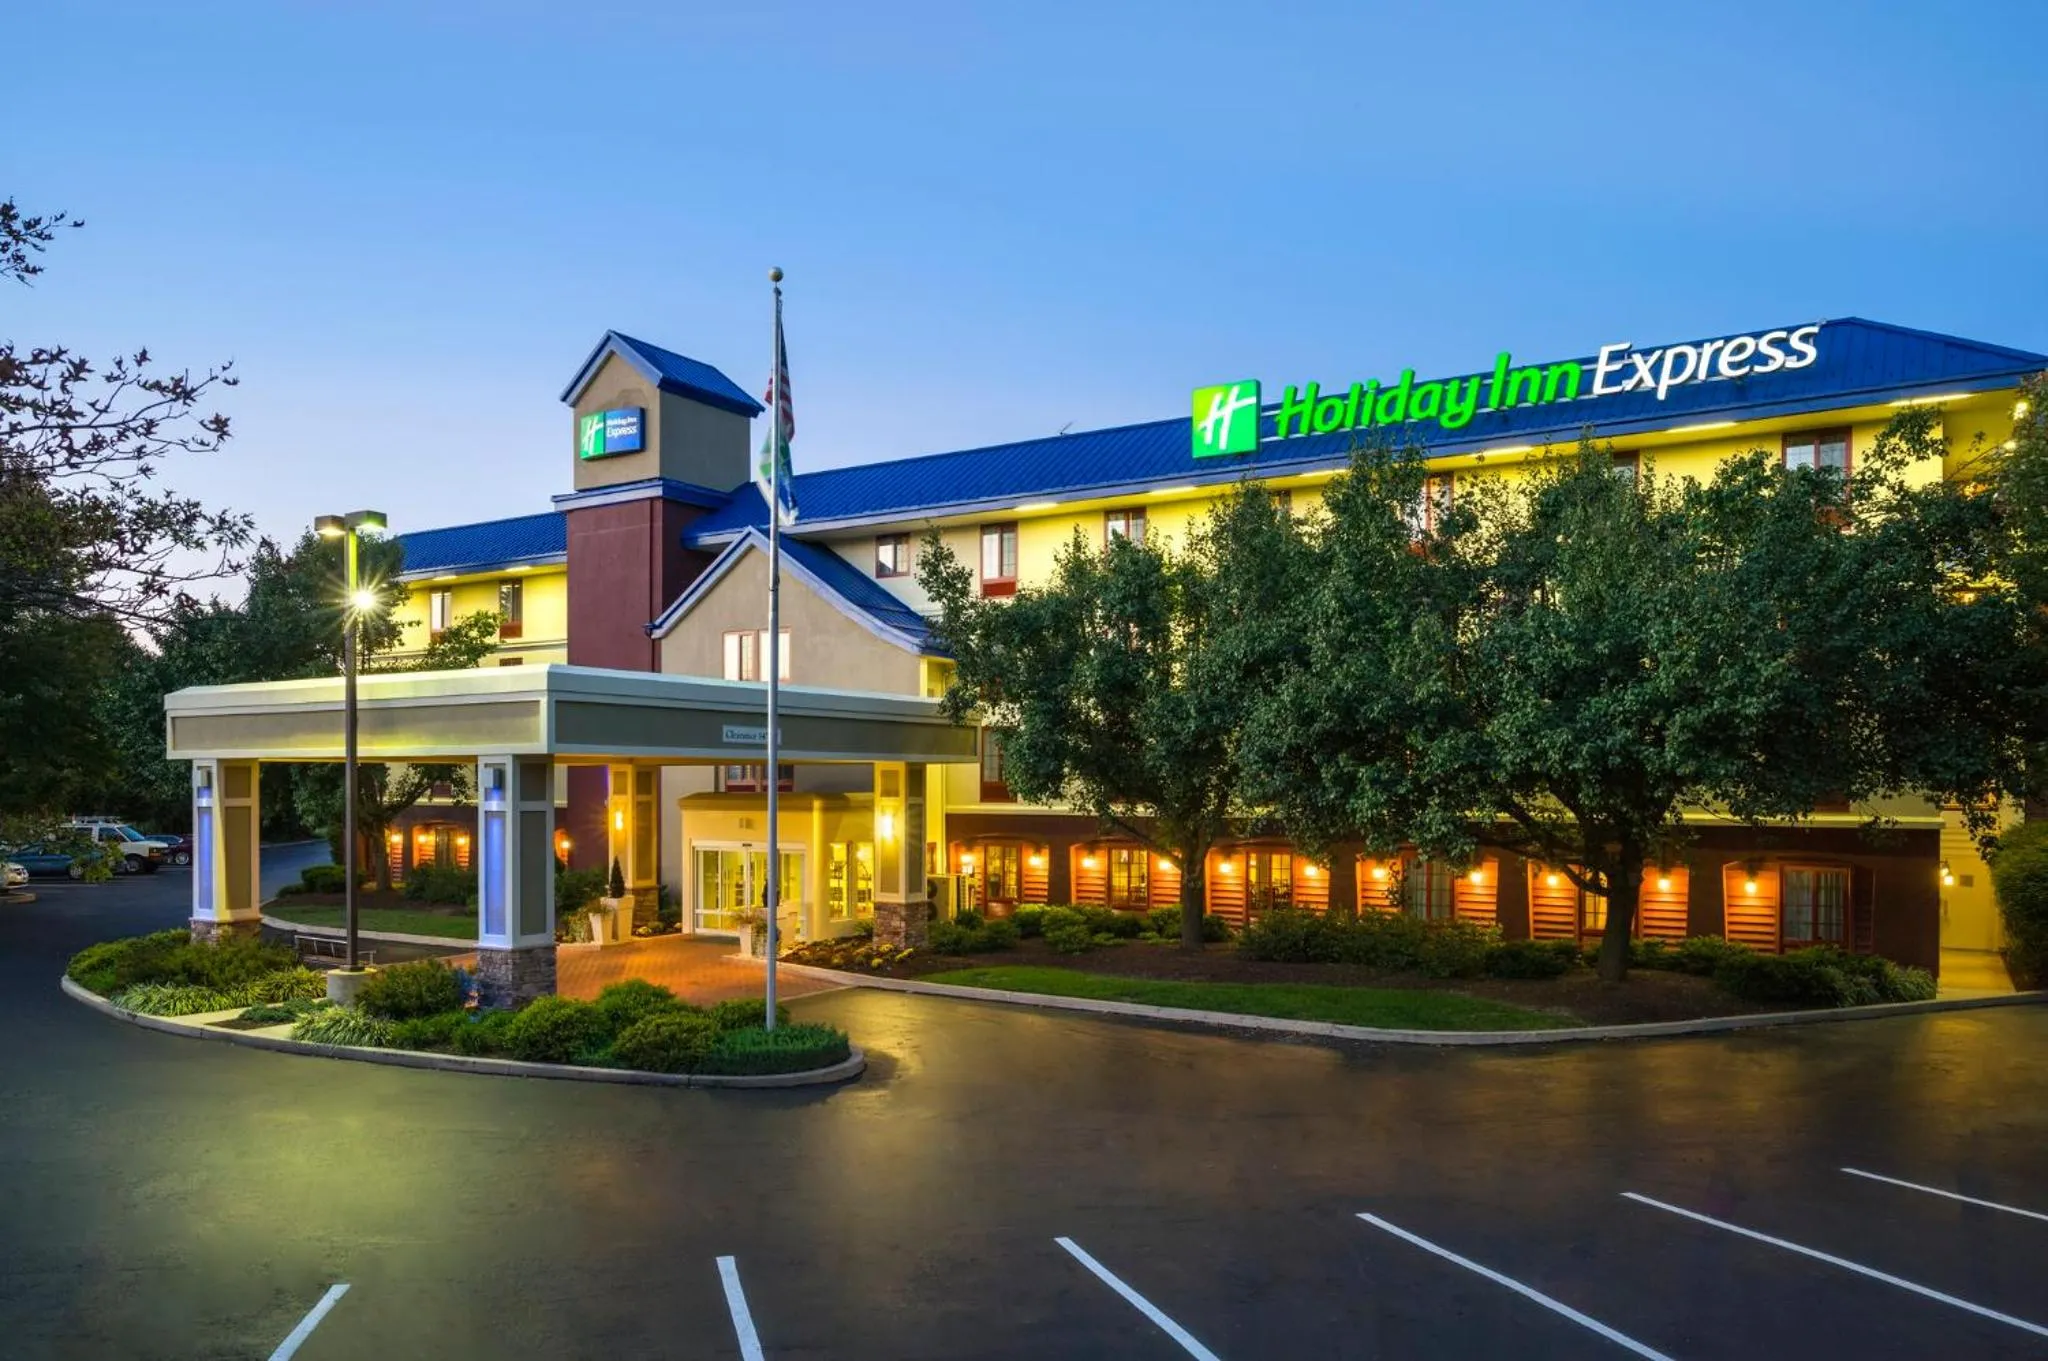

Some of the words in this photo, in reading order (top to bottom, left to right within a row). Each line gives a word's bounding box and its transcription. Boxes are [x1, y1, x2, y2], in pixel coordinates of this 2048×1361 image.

[1275, 368, 1481, 430] Holiday
[1487, 351, 1582, 411] Inn
[1592, 325, 1820, 401] Express
[606, 426, 637, 438] Express
